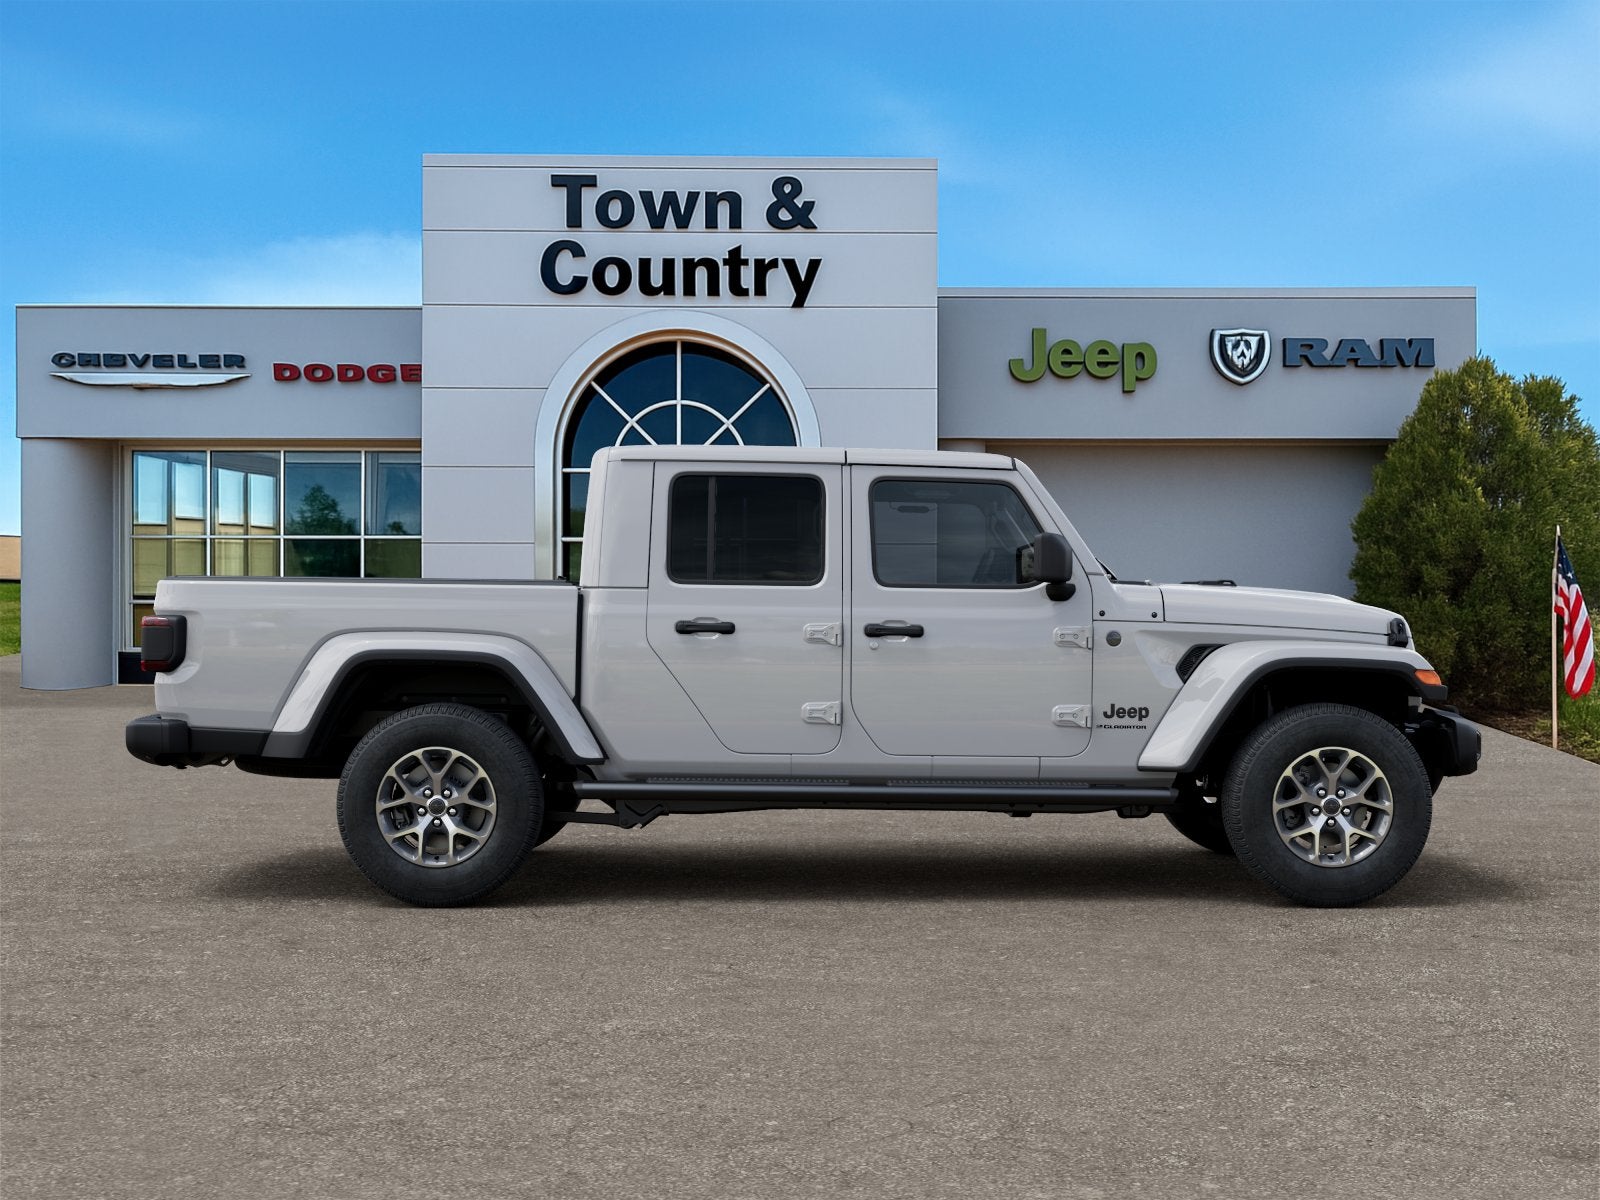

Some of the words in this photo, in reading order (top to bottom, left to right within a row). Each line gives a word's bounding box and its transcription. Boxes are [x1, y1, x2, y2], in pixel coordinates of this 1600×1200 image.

[550, 174, 742, 229] Town
[765, 175, 818, 230] &
[540, 239, 822, 308] Country
[272, 362, 422, 384] DODGE
[1009, 328, 1157, 393] Jeep
[1282, 337, 1435, 368] RAM
[1103, 703, 1149, 721] Jeep
